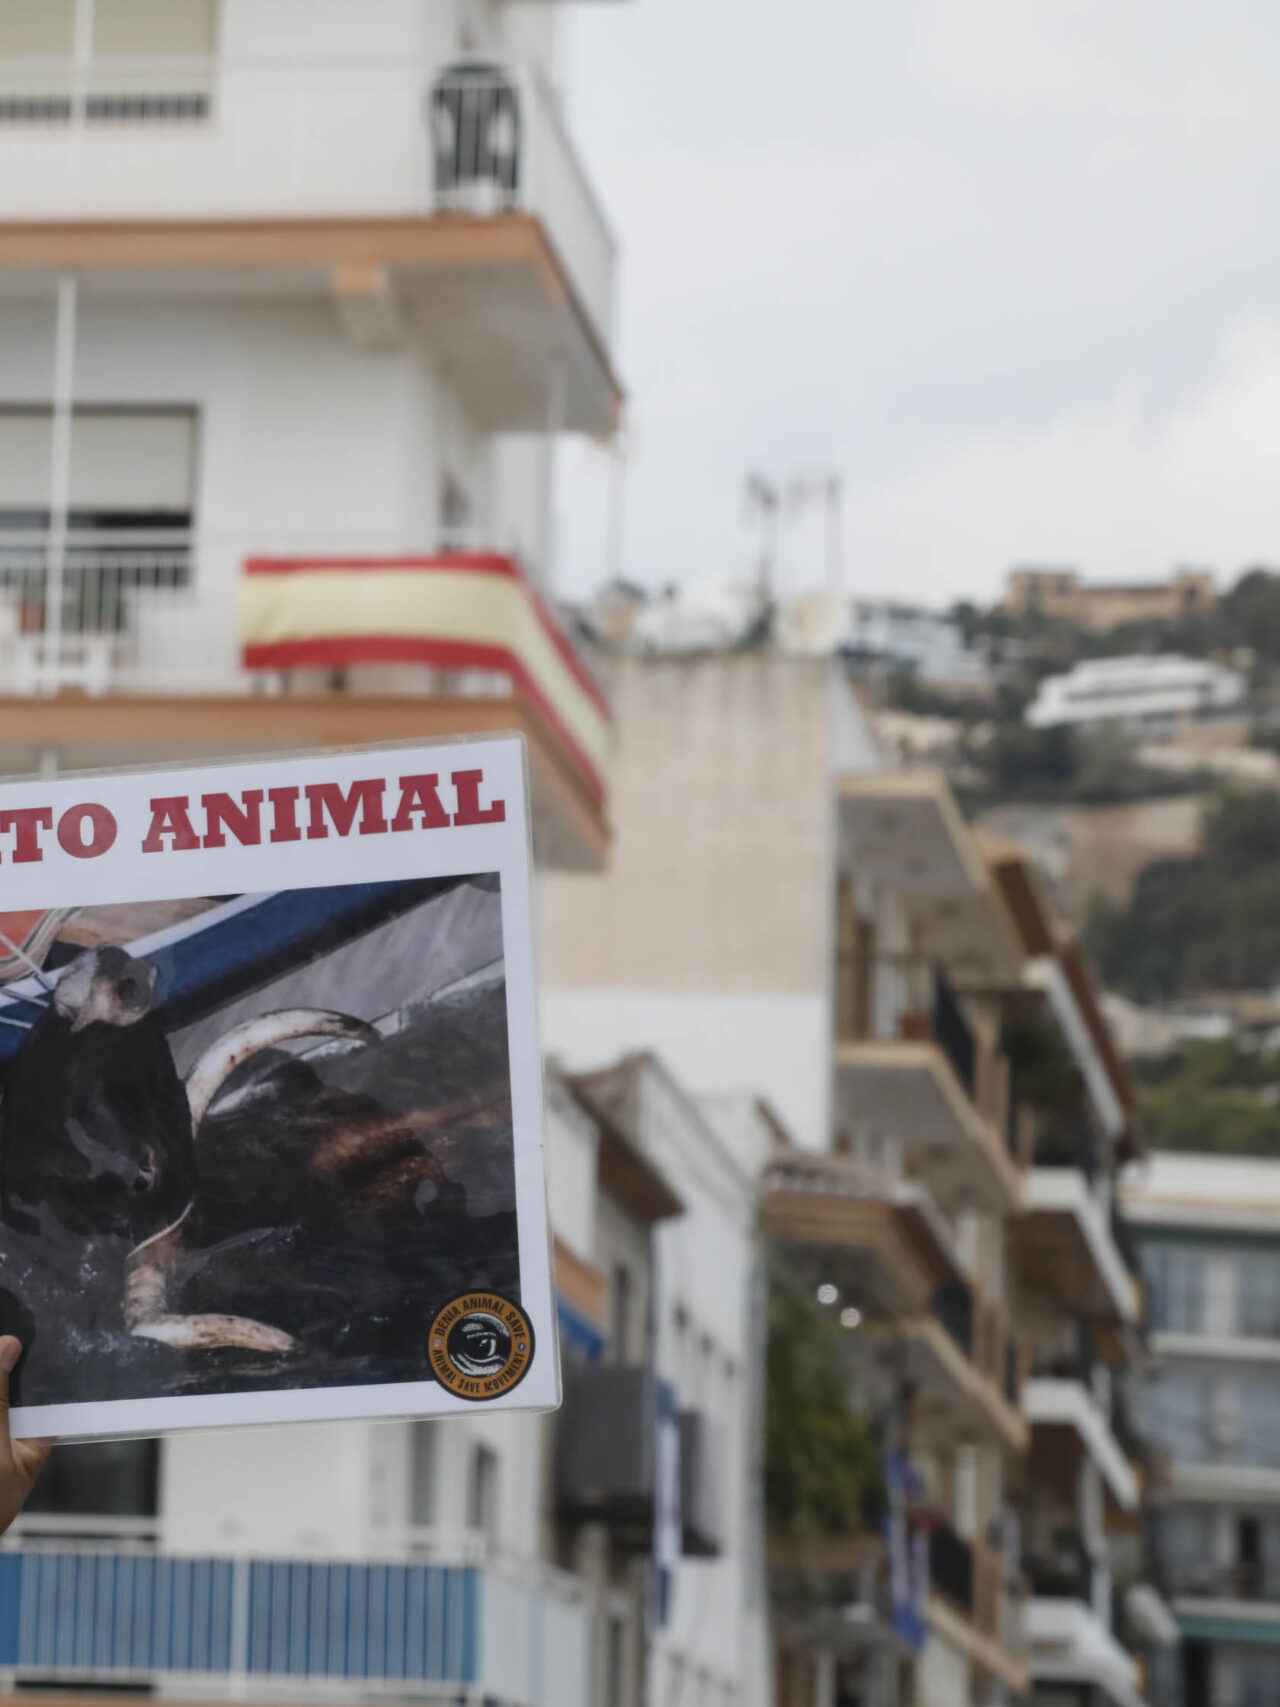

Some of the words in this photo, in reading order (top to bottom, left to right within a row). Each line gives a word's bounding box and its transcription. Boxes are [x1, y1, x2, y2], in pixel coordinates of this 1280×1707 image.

[143, 769, 505, 852] ANIMAL
[434, 1306, 461, 1336] DENIA
[463, 1297, 505, 1315] ANIMAL
[505, 1311, 526, 1340] SAVE
[432, 1350, 456, 1383] ANIMAL
[458, 1378, 481, 1393] SAVE
[484, 1353, 525, 1392] MOVEMENT
